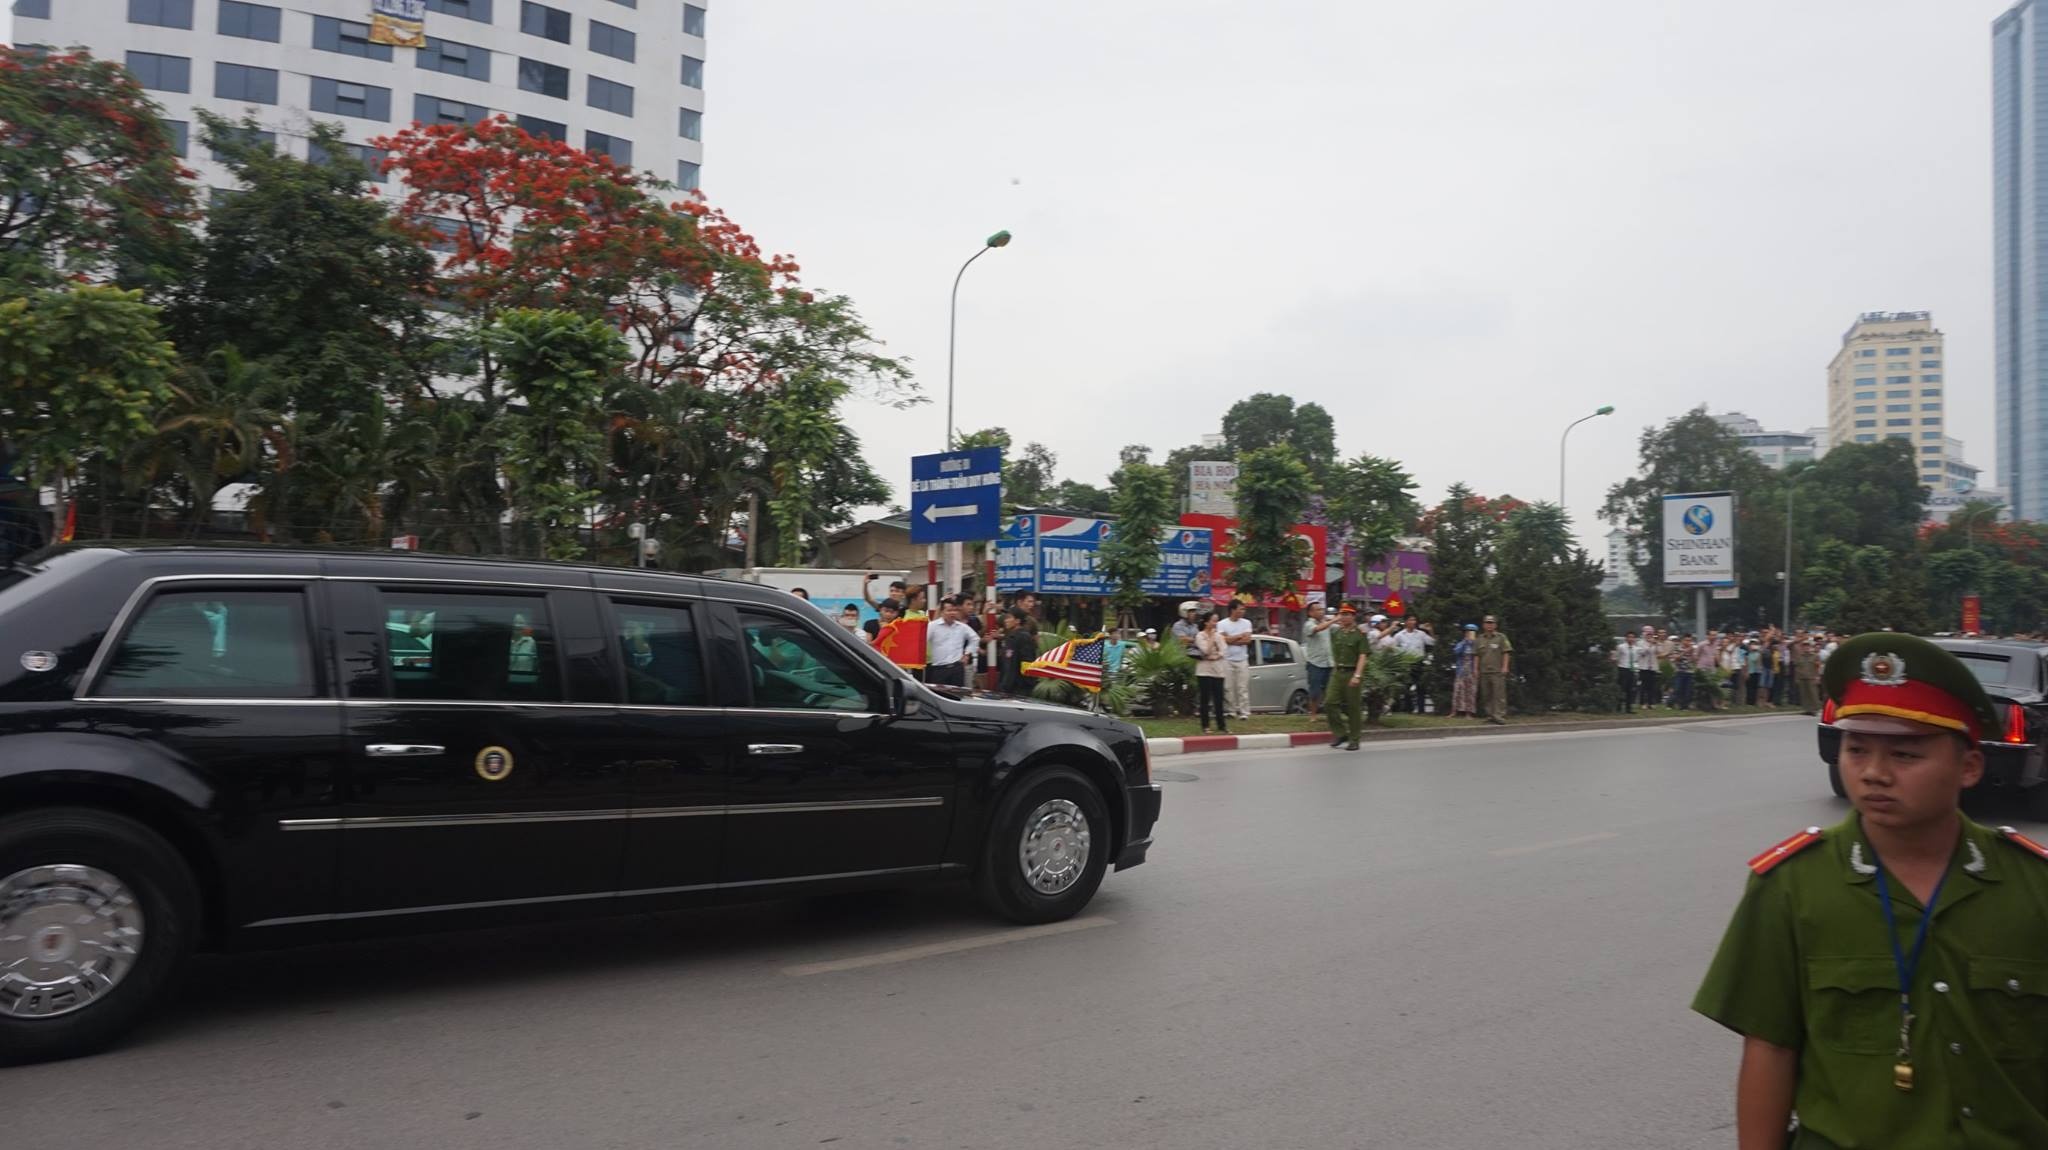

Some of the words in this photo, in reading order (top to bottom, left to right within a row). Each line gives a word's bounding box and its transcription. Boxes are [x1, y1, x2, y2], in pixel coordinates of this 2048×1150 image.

[1666, 537, 1731, 550] SHINHAN
[1042, 546, 1090, 571] TRANG
[1679, 554, 1719, 566] BANK
